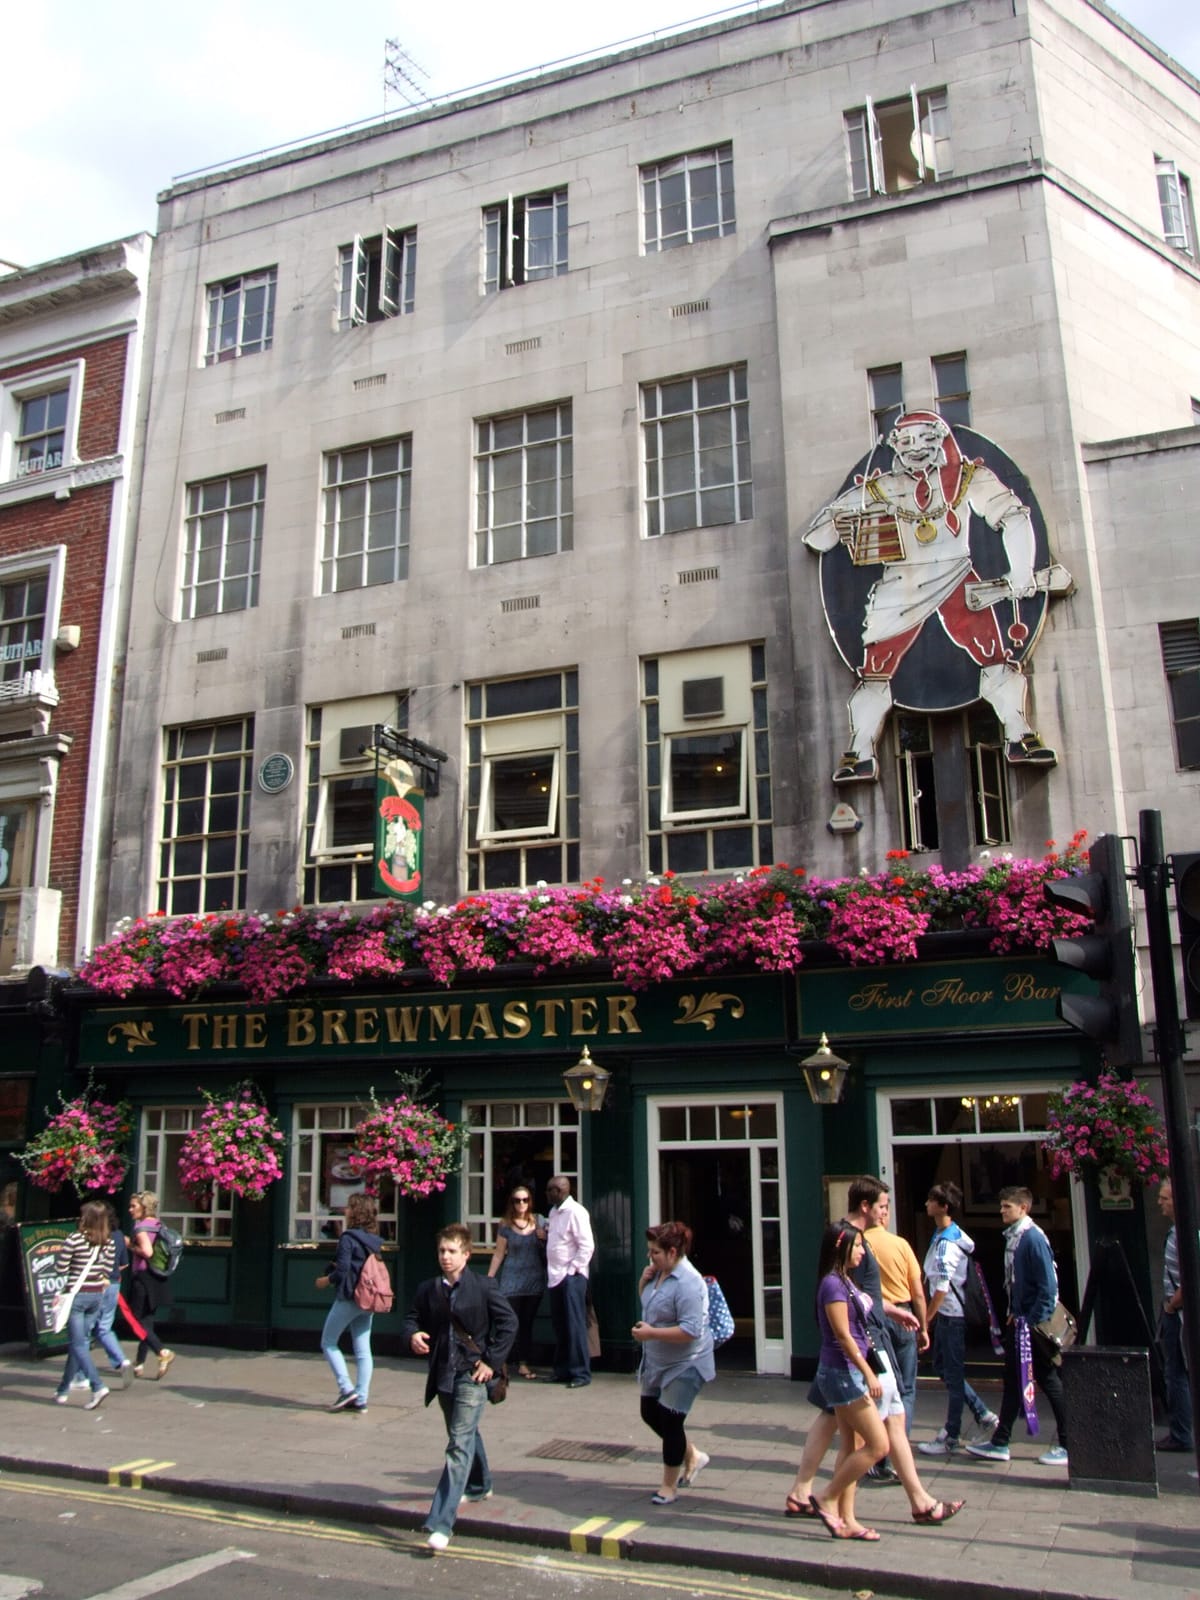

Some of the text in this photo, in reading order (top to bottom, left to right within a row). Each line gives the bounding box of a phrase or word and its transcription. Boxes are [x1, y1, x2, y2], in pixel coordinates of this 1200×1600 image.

[849, 973, 1061, 1011] First Floor Bar
[182, 995, 642, 1049] THE BREWMASTER
